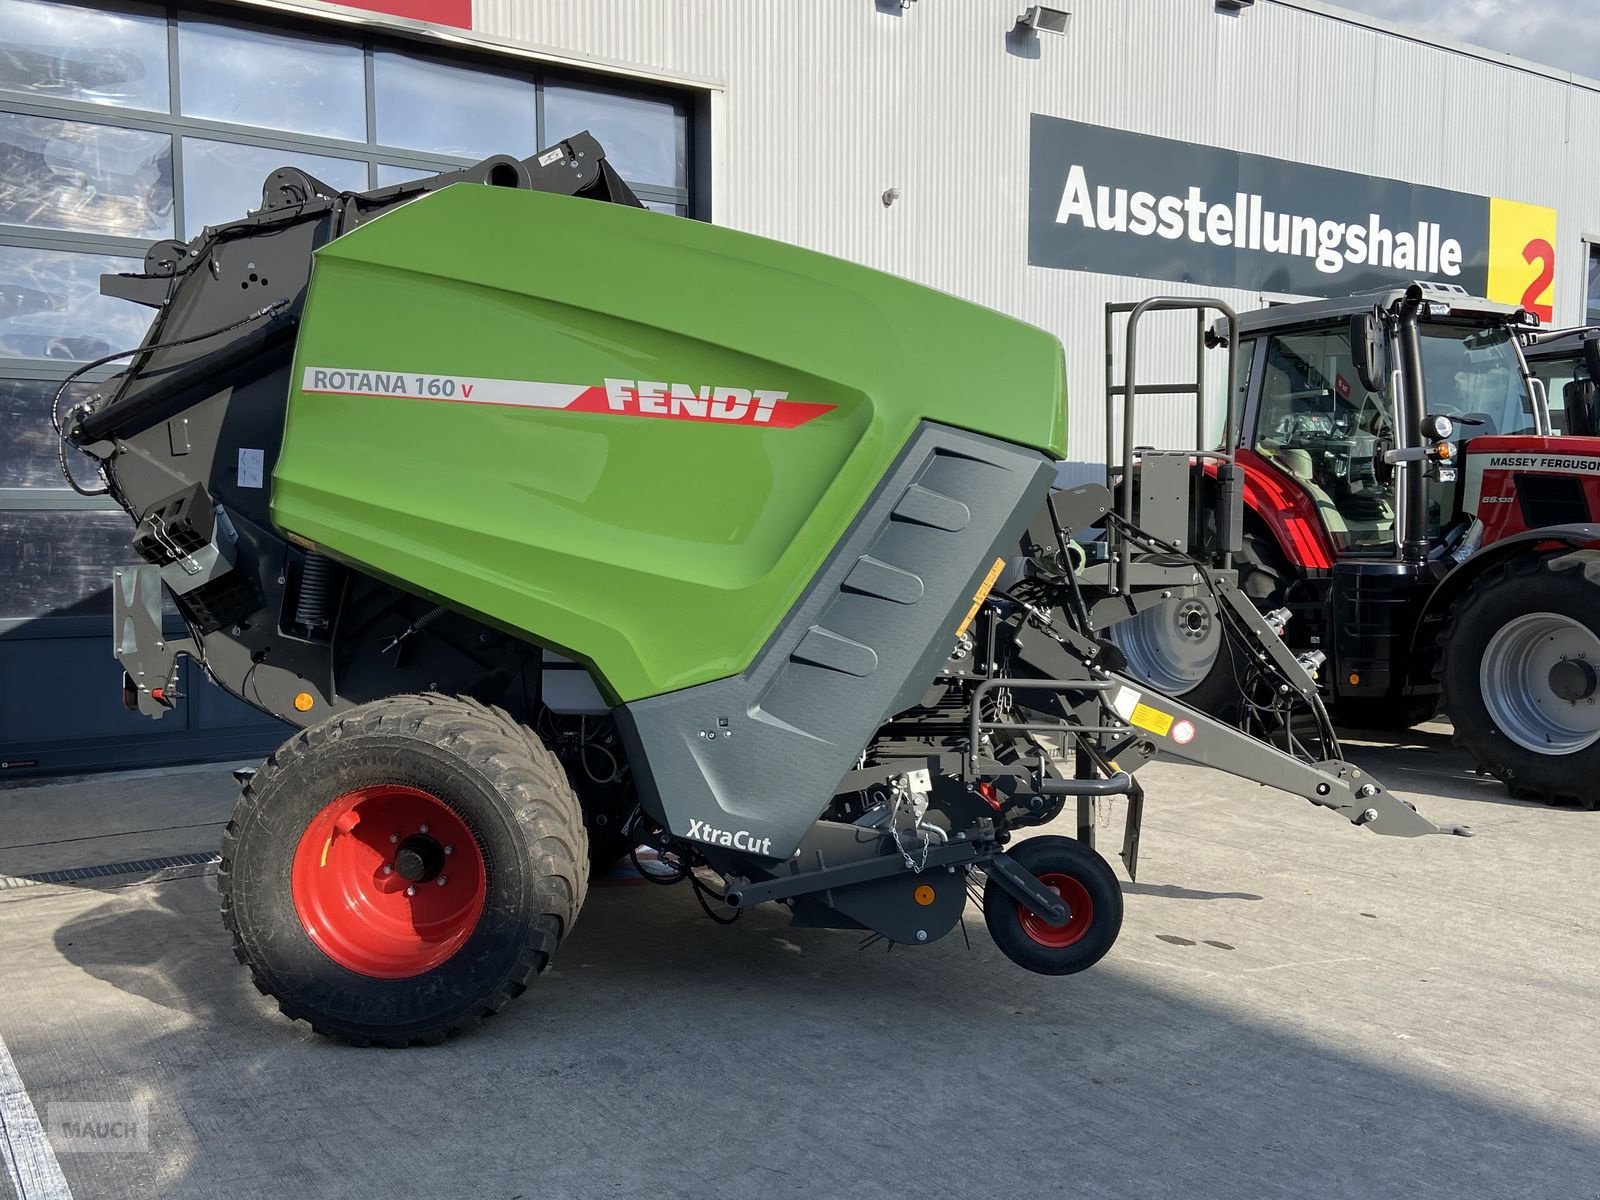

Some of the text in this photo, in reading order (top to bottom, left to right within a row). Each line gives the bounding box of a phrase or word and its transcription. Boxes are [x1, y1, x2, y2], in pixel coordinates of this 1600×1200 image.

[1055, 164, 1555, 323] Ausstellungshalle 2
[314, 370, 407, 394] ROTANA
[415, 377, 455, 397] 160
[603, 377, 789, 423] FENDT
[1490, 457, 1538, 467] MASSEY
[686, 818, 772, 855] XtraCut
